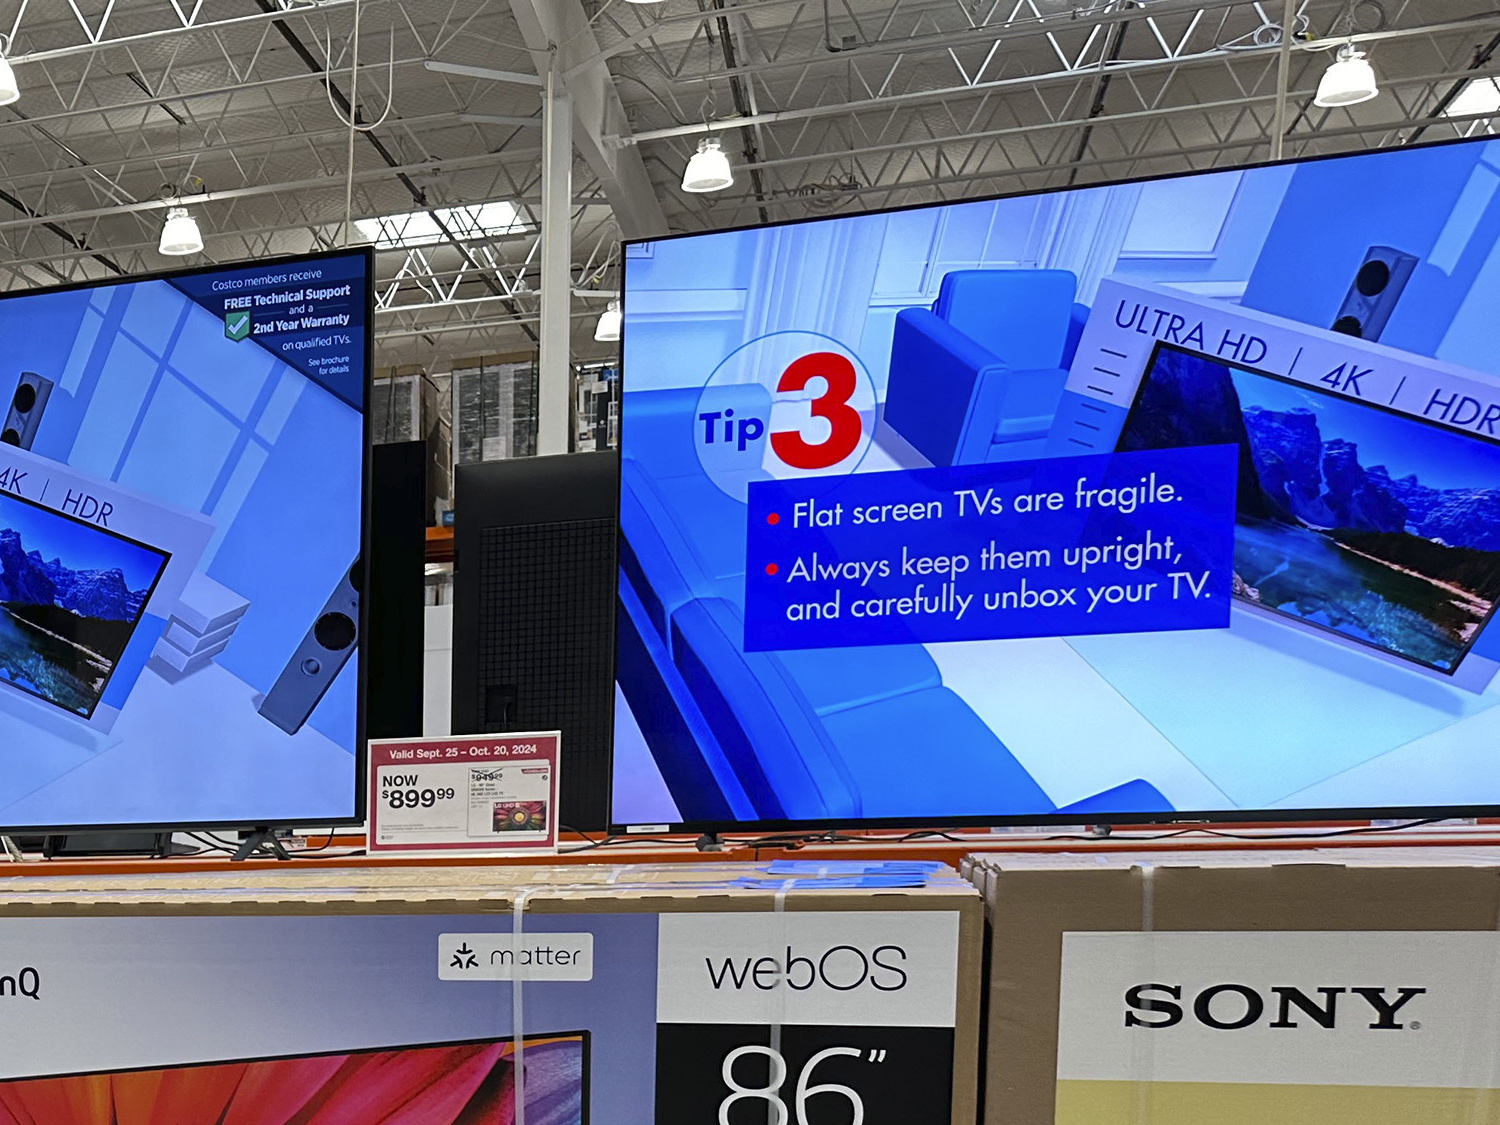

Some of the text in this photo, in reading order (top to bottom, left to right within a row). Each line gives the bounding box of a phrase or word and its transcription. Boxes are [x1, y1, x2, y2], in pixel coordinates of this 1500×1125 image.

[212, 269, 322, 291] Costco members receive
[224, 284, 351, 310] FREE Technical Support
[288, 304, 315, 316] and a
[253, 313, 351, 334] 2nd Year Warranty
[282, 333, 351, 352] on qualified TVs.
[1114, 299, 1205, 351] ULTRA
[1216, 329, 1268, 365] HD
[1319, 362, 1374, 396] 4K
[698, 351, 862, 470] Tip 3
[61, 488, 115, 527] HDR
[793, 472, 1184, 529] Flat screen TVs are fragile.
[786, 529, 1183, 587] Always keep them upright,
[786, 570, 1212, 621] and carefully unbox your TV.
[389, 744, 538, 760] Valid Sept. 25 Oct. 20, 2024
[382, 774, 418, 788] NOW
[490, 945, 581, 966] matter
[704, 945, 908, 991] webOS
[1124, 983, 1427, 1031] SONY
